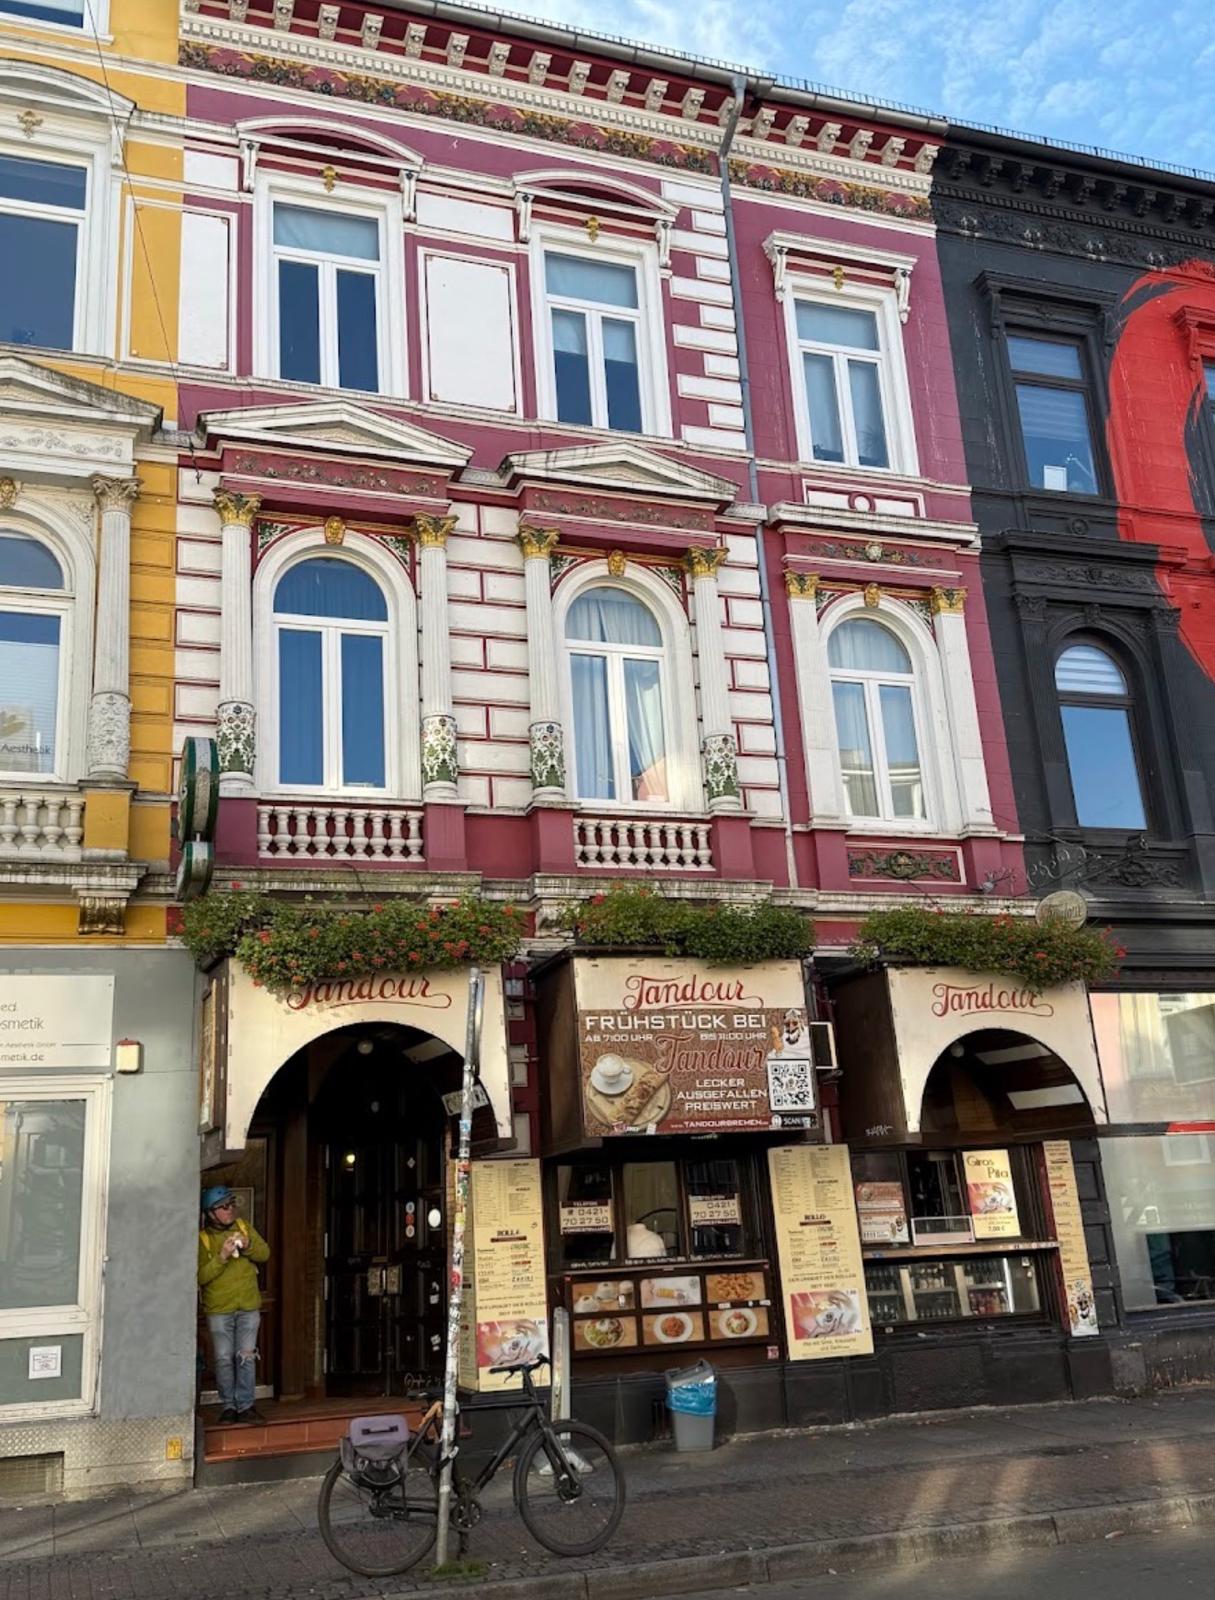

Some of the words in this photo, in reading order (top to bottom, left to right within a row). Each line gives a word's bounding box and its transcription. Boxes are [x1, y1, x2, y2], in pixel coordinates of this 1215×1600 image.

[623, 974, 764, 1009] Tandour
[931, 982, 1054, 1017] Tandour
[0, 1017, 44, 1030] smetik
[585, 1011, 726, 1030] FRÜHSTÜCK
[733, 1014, 766, 1028] BEI
[585, 1034, 601, 1042] AB
[630, 1033, 654, 1041] UHR
[745, 1032, 767, 1040] UHR
[655, 1033, 765, 1073] Tandour
[696, 1078, 745, 1088] LECKER
[677, 1089, 767, 1100] AUSGEFALLEN
[685, 1100, 757, 1111] PREISWERT
